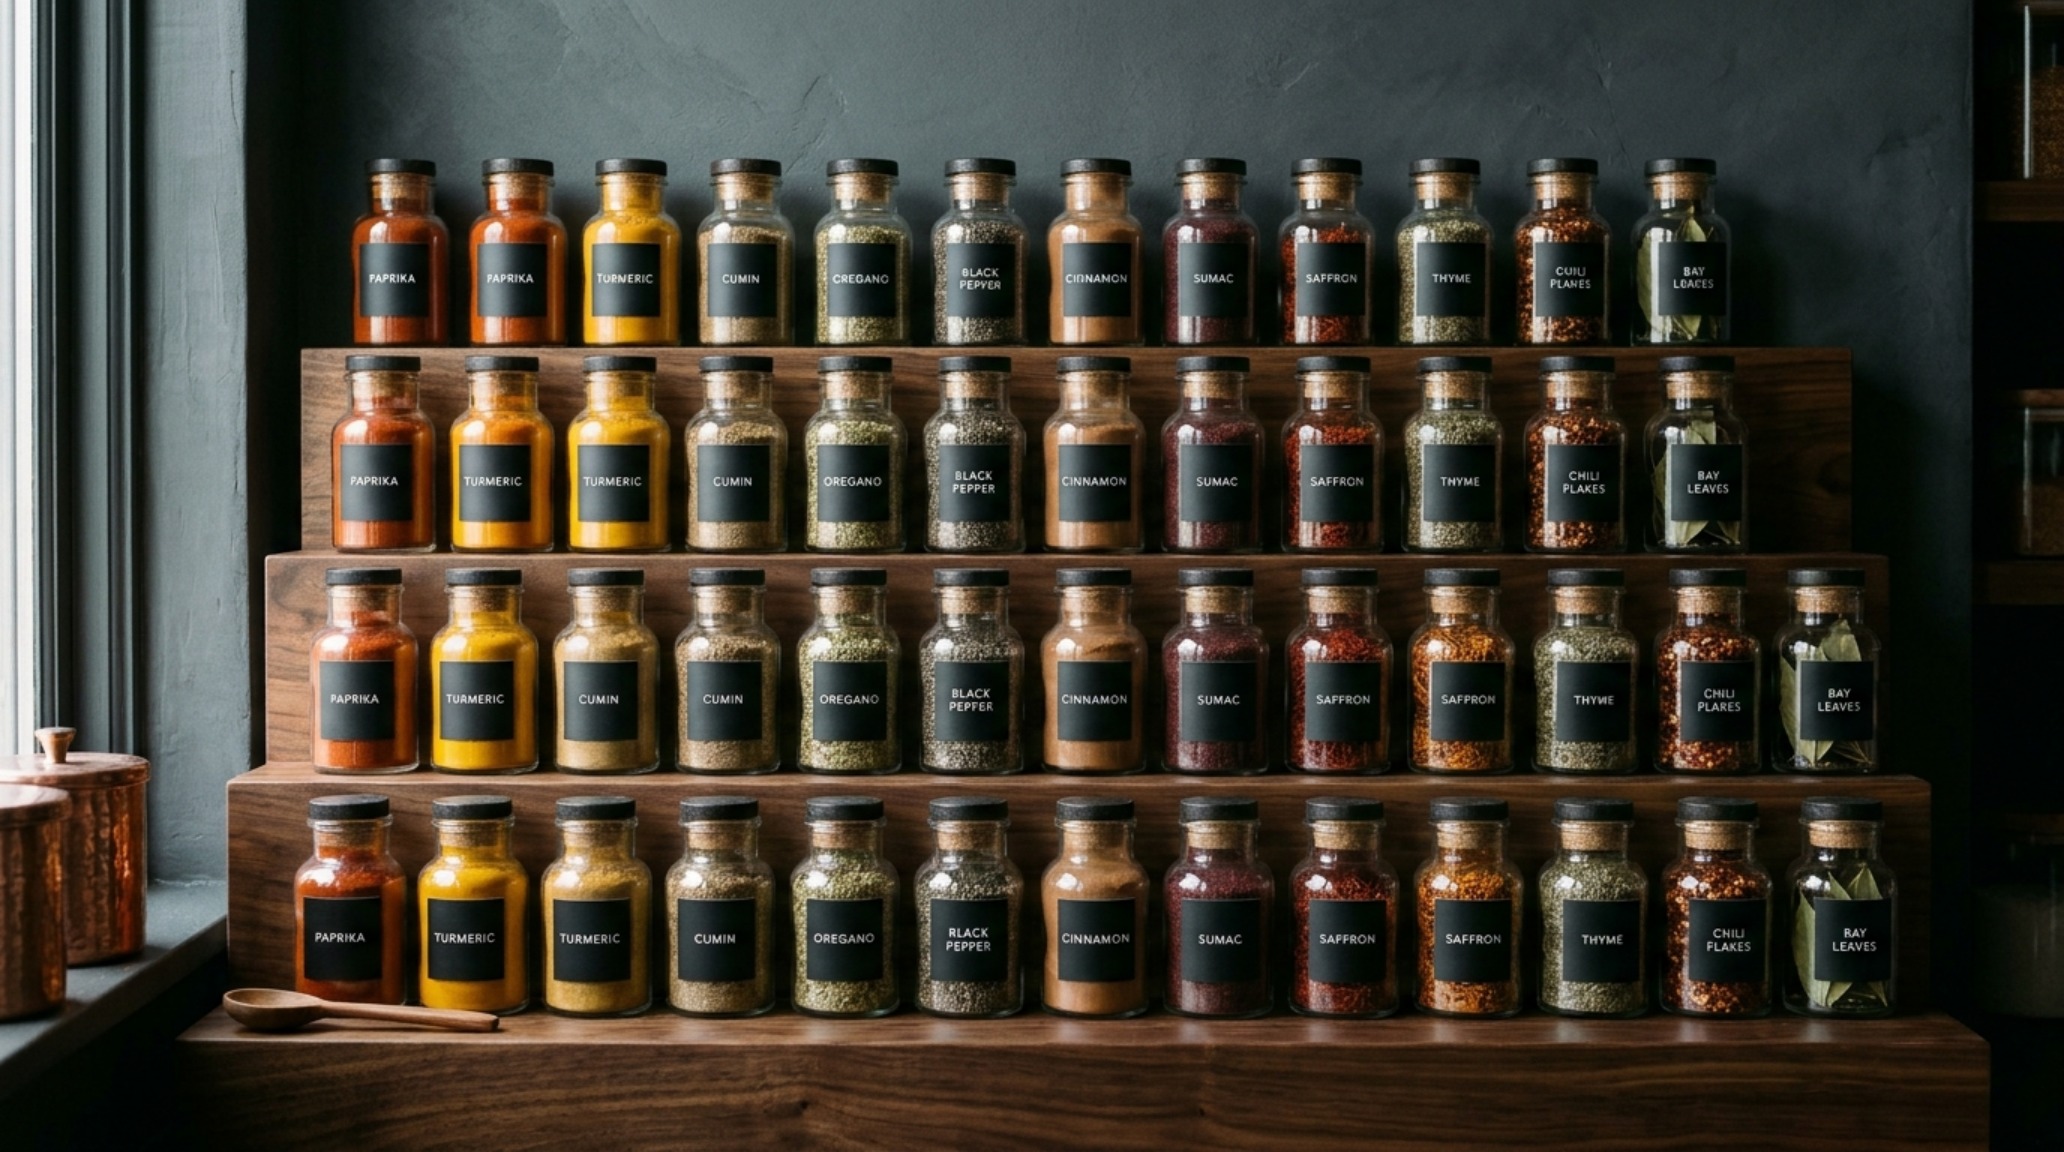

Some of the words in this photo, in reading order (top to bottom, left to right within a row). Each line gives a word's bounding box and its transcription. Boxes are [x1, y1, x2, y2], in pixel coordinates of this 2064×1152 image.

[1683, 266, 1706, 277] BAY
[368, 273, 417, 284] PAPRIKA
[486, 273, 535, 284] PAPRIKA
[722, 273, 760, 284] CUMIN
[1193, 273, 1234, 284] SUMAC
[1432, 273, 1472, 284] THYME
[350, 476, 399, 486] PAPRIKA
[955, 470, 993, 481] BLACK
[1697, 470, 1720, 481] BAY
[463, 476, 523, 487] TURMERIC
[582, 476, 643, 487] TURMERIC
[713, 476, 753, 487] CUMIN
[823, 476, 883, 487] OREGANO
[1061, 476, 1127, 487] CINNAMON
[1196, 476, 1239, 487] SUMAC
[1310, 476, 1365, 487] SAFFRON
[952, 483, 996, 494] PEPPER
[951, 687, 991, 699] BLACK
[1827, 687, 1852, 699] BAY
[330, 693, 380, 705] PAPRIKA
[578, 694, 619, 705] CUMIN
[702, 693, 744, 705] CUMIN
[819, 693, 880, 705] OREGANO
[1061, 693, 1128, 705] CINNAMON
[1197, 694, 1241, 706] SUMAC
[1315, 694, 1371, 705] SAFFRON
[1817, 701, 1861, 712] LEAVES
[314, 931, 366, 943] PAPRIKA
[433, 932, 496, 945] TURMERIC
[559, 932, 621, 945] TURMERIC
[693, 933, 736, 945] CUMIN
[813, 932, 875, 945] OREGANO
[1061, 932, 1130, 945] CINNAMON
[1198, 933, 1243, 945] SUMAC
[1445, 933, 1502, 945] SAFFRON
[1581, 933, 1624, 945] THYME
[945, 940, 991, 952] PEPPER
[1706, 941, 1752, 953] FLAKES
[1832, 941, 1878, 952] LEAVES
